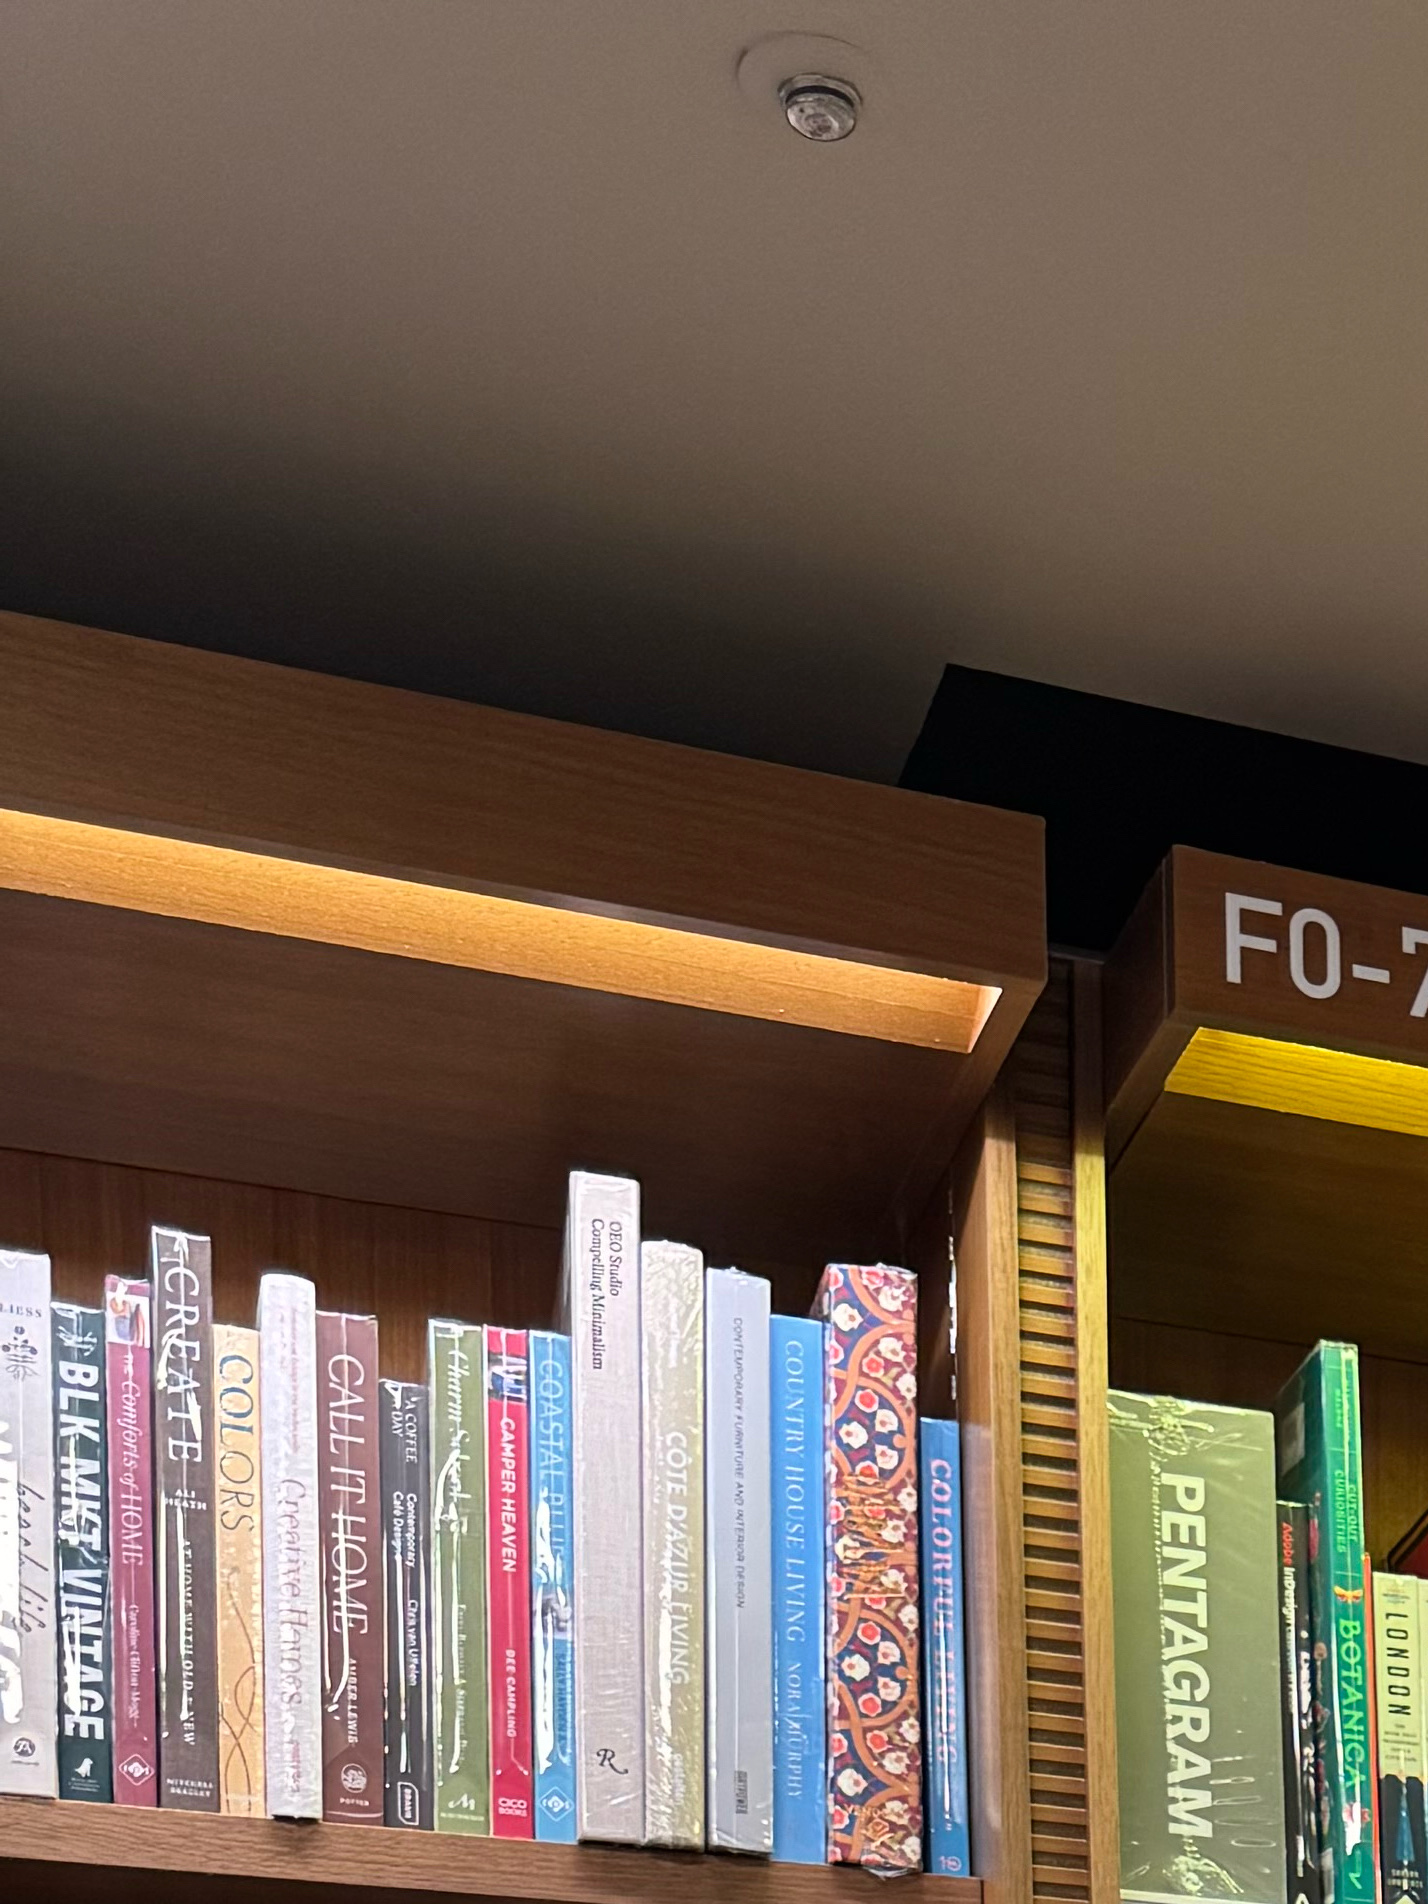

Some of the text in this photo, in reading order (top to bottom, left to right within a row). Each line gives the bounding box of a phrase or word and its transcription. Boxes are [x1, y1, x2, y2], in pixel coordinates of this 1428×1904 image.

[589, 1218, 605, 1370] Compelling Minimalism
[609, 1220, 623, 1296] OEO Studio
[59, 1361, 100, 1442] BLK
[164, 1267, 202, 1463] CREATE
[219, 1354, 256, 1531] COLORS
[328, 1354, 368, 1635] CALL IT HOME
[785, 1340, 805, 1642] COUNTRY HOUSE LIVING
[62, 1568, 104, 1740] VINTAGE
[1162, 1471, 1213, 1838] PENTAGRAM
[1385, 1611, 1412, 1717] LONDON
